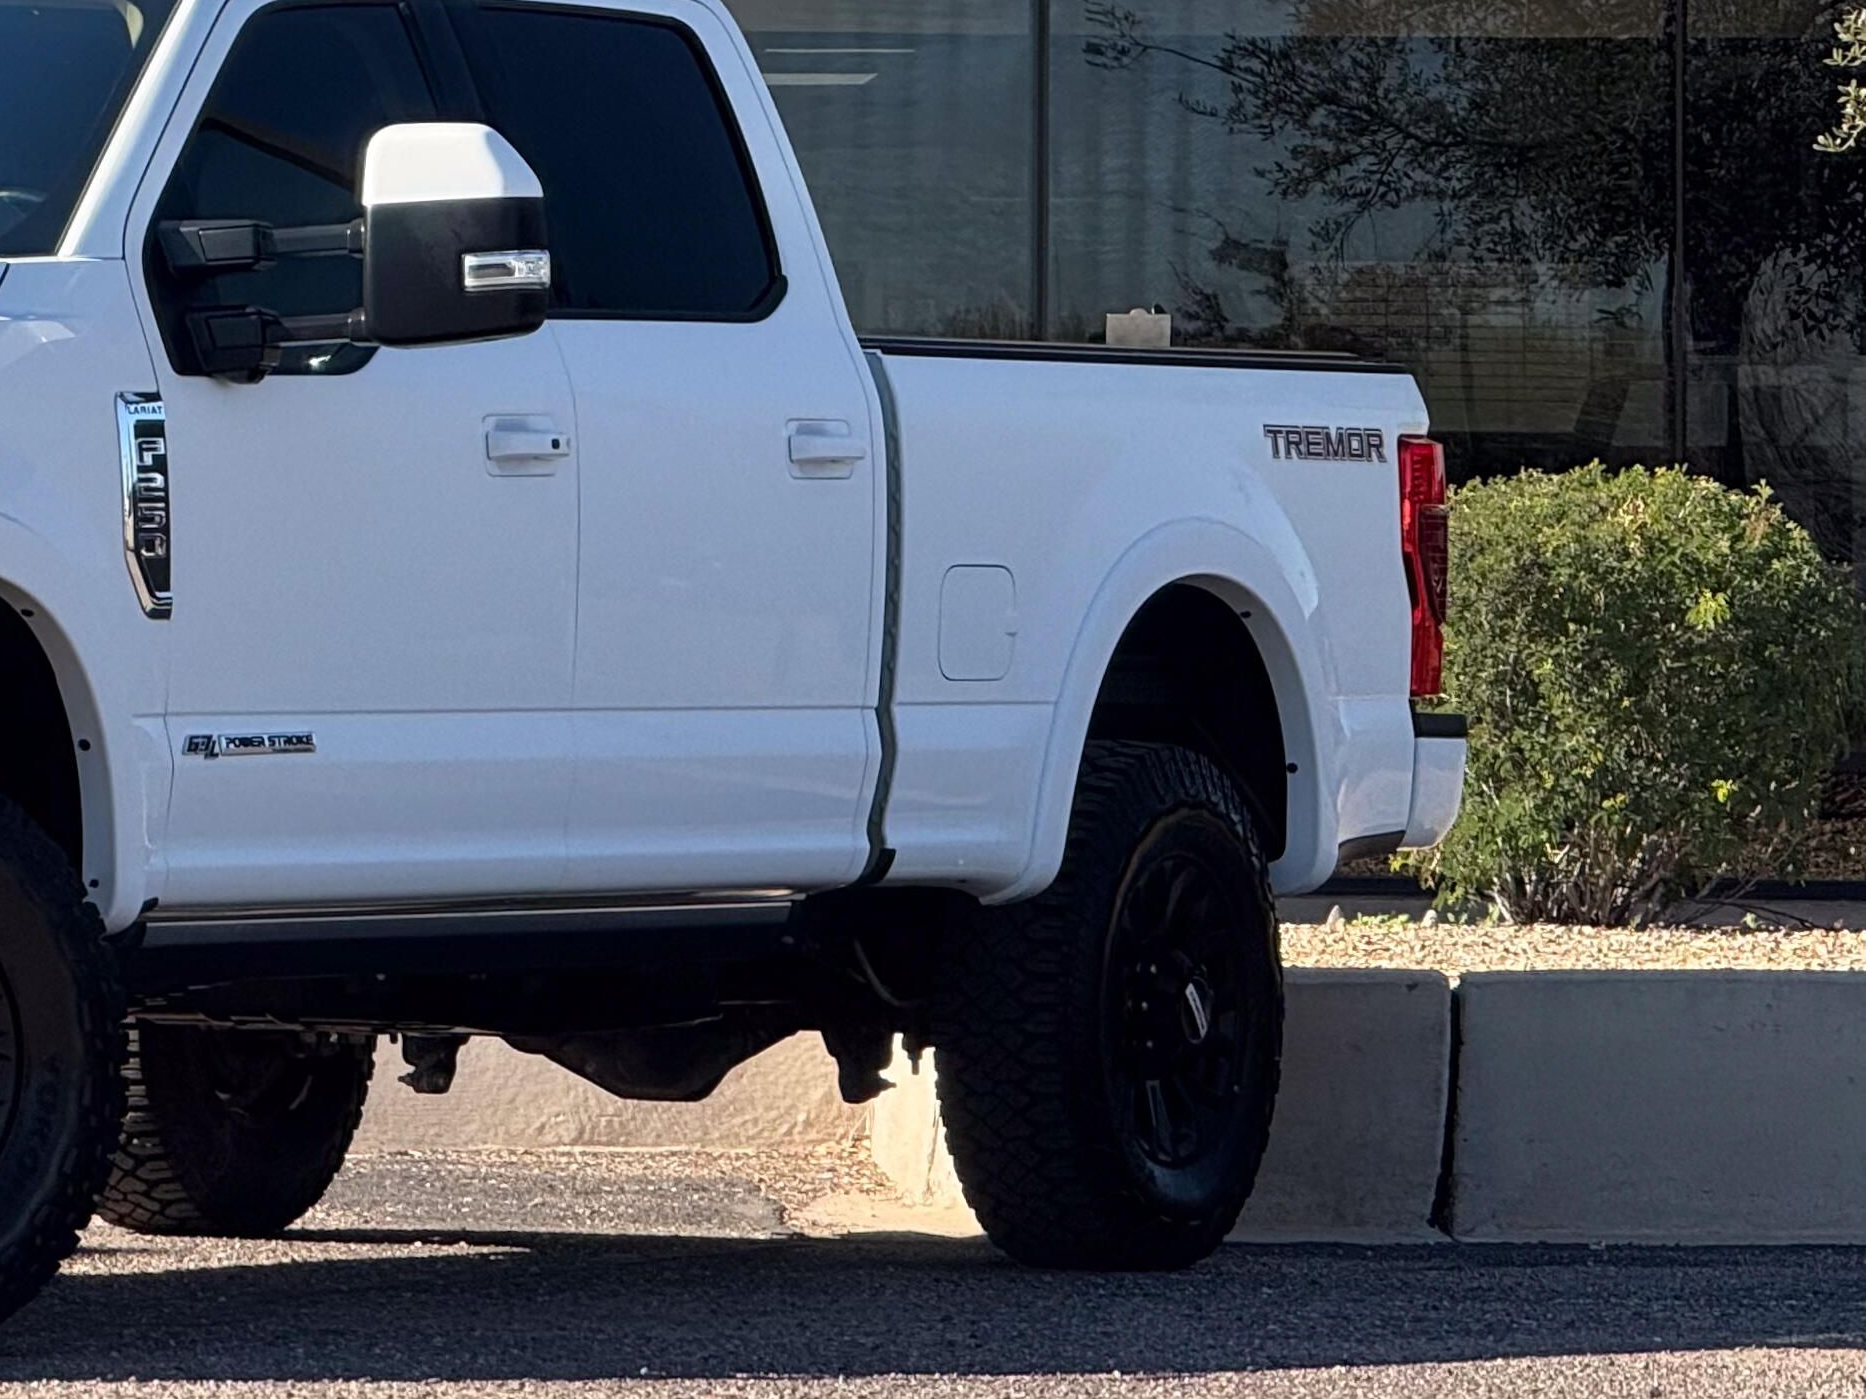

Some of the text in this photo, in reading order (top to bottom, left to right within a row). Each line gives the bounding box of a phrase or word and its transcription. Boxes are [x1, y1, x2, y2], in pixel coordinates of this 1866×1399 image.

[127, 405, 162, 415] LARIAT
[1263, 424, 1387, 462] TREMOR
[224, 736, 266, 749] POWER
[267, 733, 313, 747] STROKE
